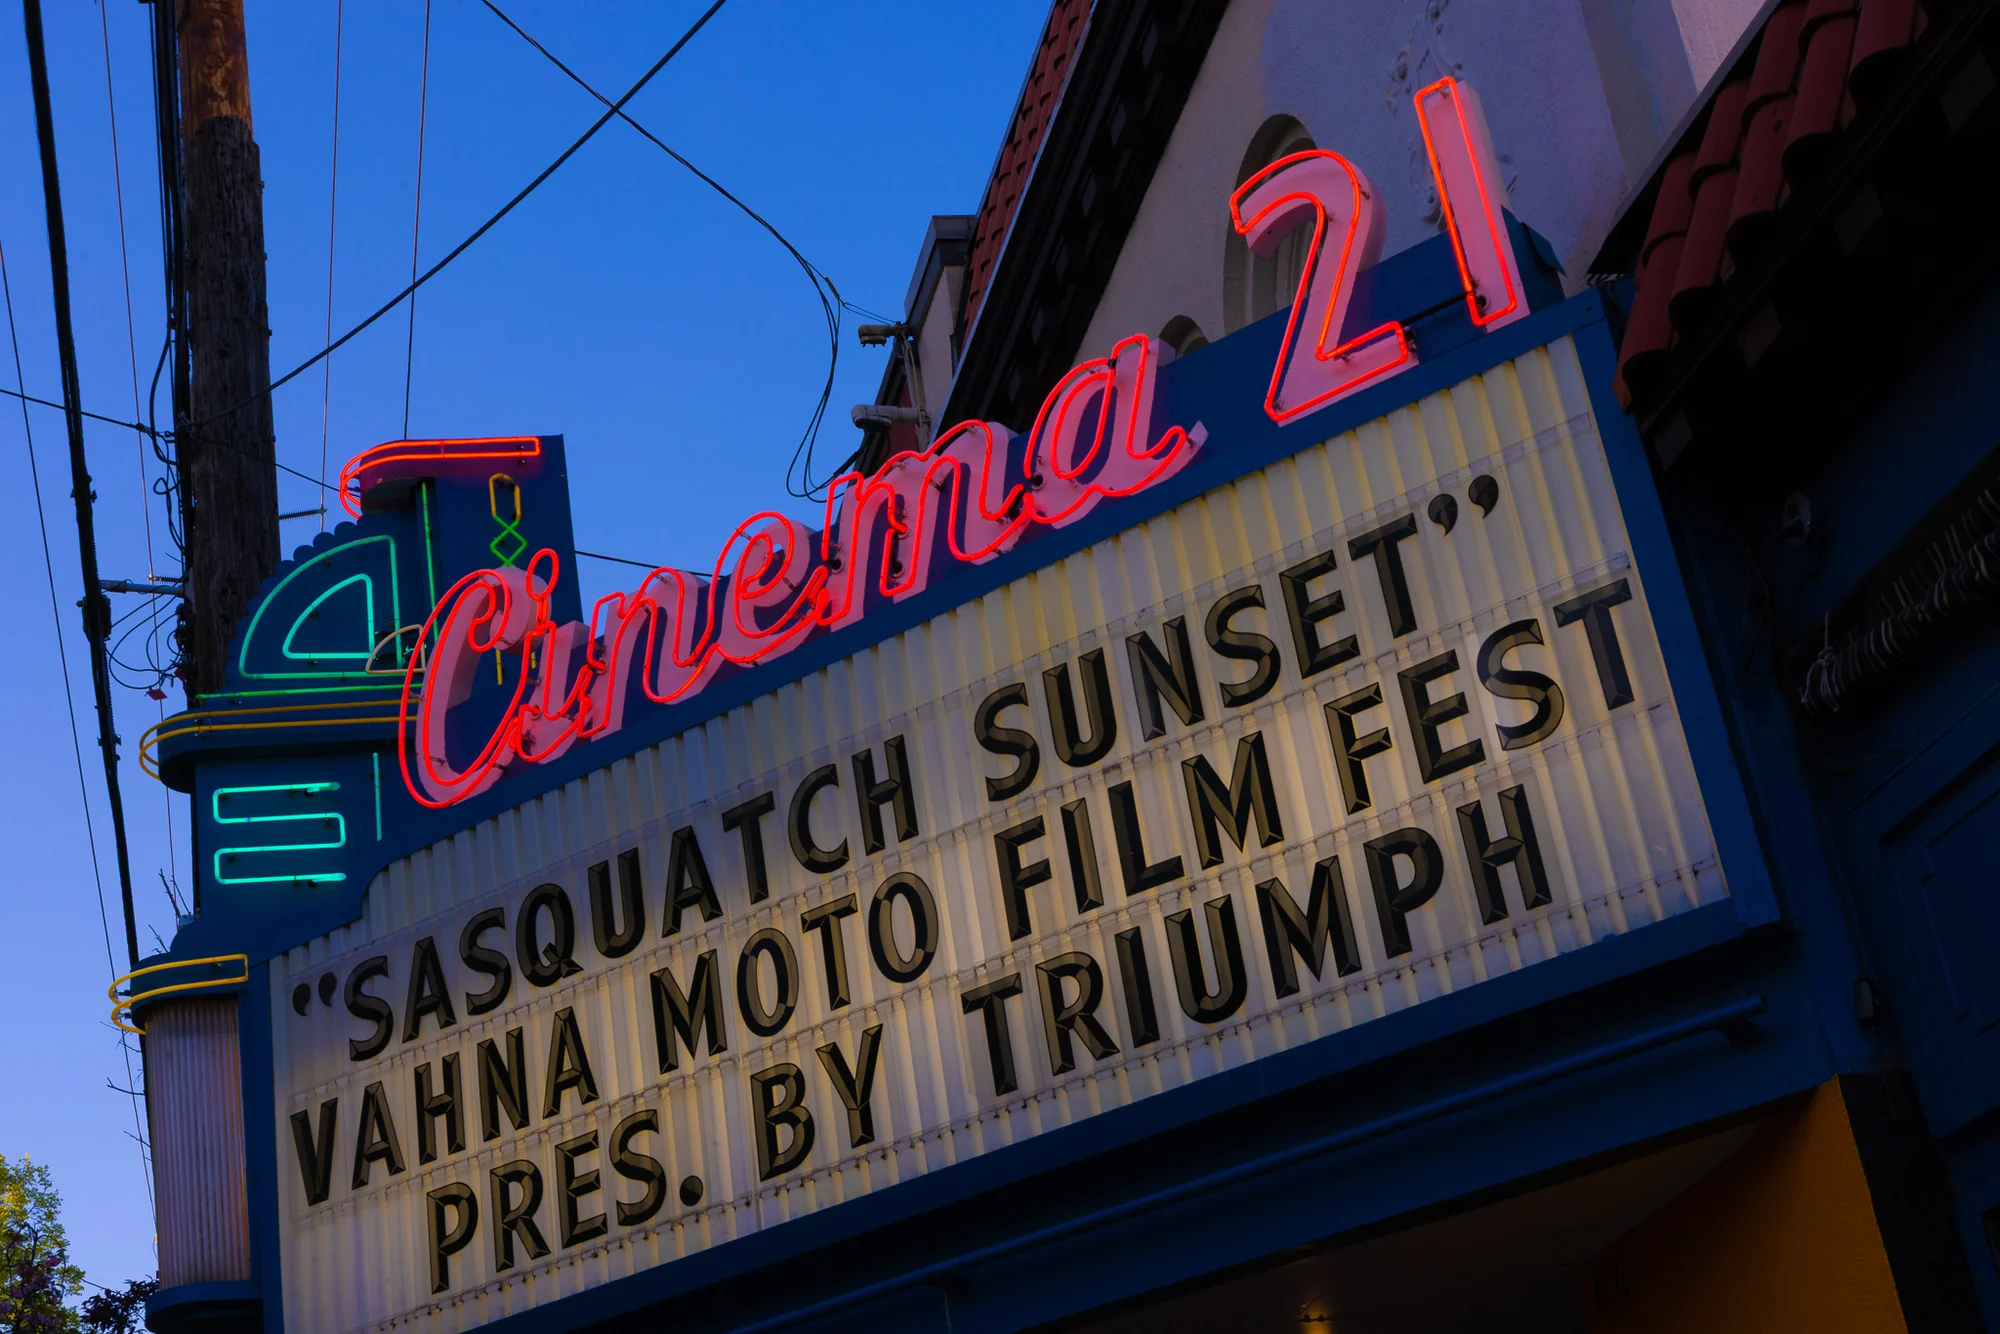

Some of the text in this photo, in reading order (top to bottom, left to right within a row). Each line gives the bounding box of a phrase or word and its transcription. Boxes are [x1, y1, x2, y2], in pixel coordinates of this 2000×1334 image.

[399, 76, 1530, 809] Cinema 21
[290, 577, 1635, 1206] VAHNA MOTO FILM FEST
[292, 474, 1499, 1062] "SASQUATCH SUNSET"
[427, 784, 1553, 1294] PRES. BY TRIUMPH
